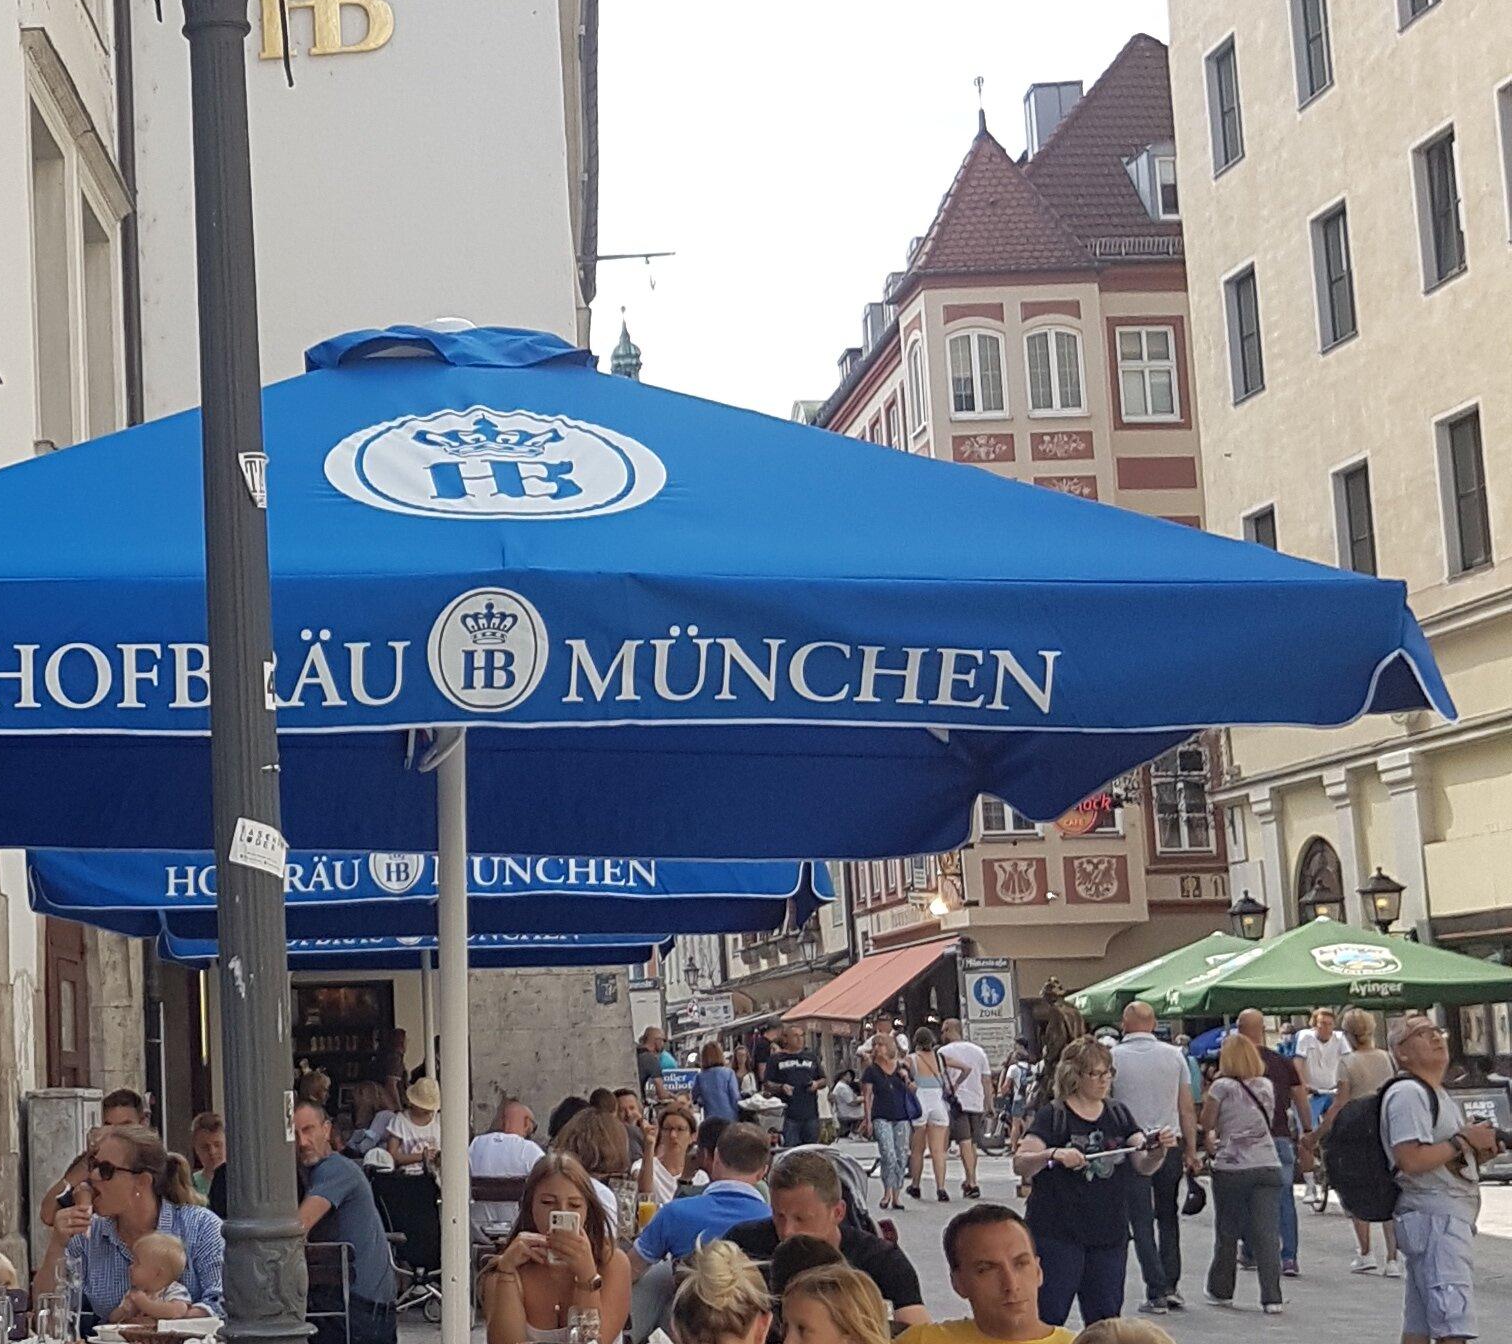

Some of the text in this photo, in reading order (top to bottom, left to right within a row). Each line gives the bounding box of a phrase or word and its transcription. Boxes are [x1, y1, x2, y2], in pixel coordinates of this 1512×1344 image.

[423, 459, 583, 501] HB
[461, 649, 516, 690] HB
[562, 625, 1062, 714] MÜNCHEN
[385, 861, 410, 883] HB
[1349, 979, 1403, 997] Ayinger
